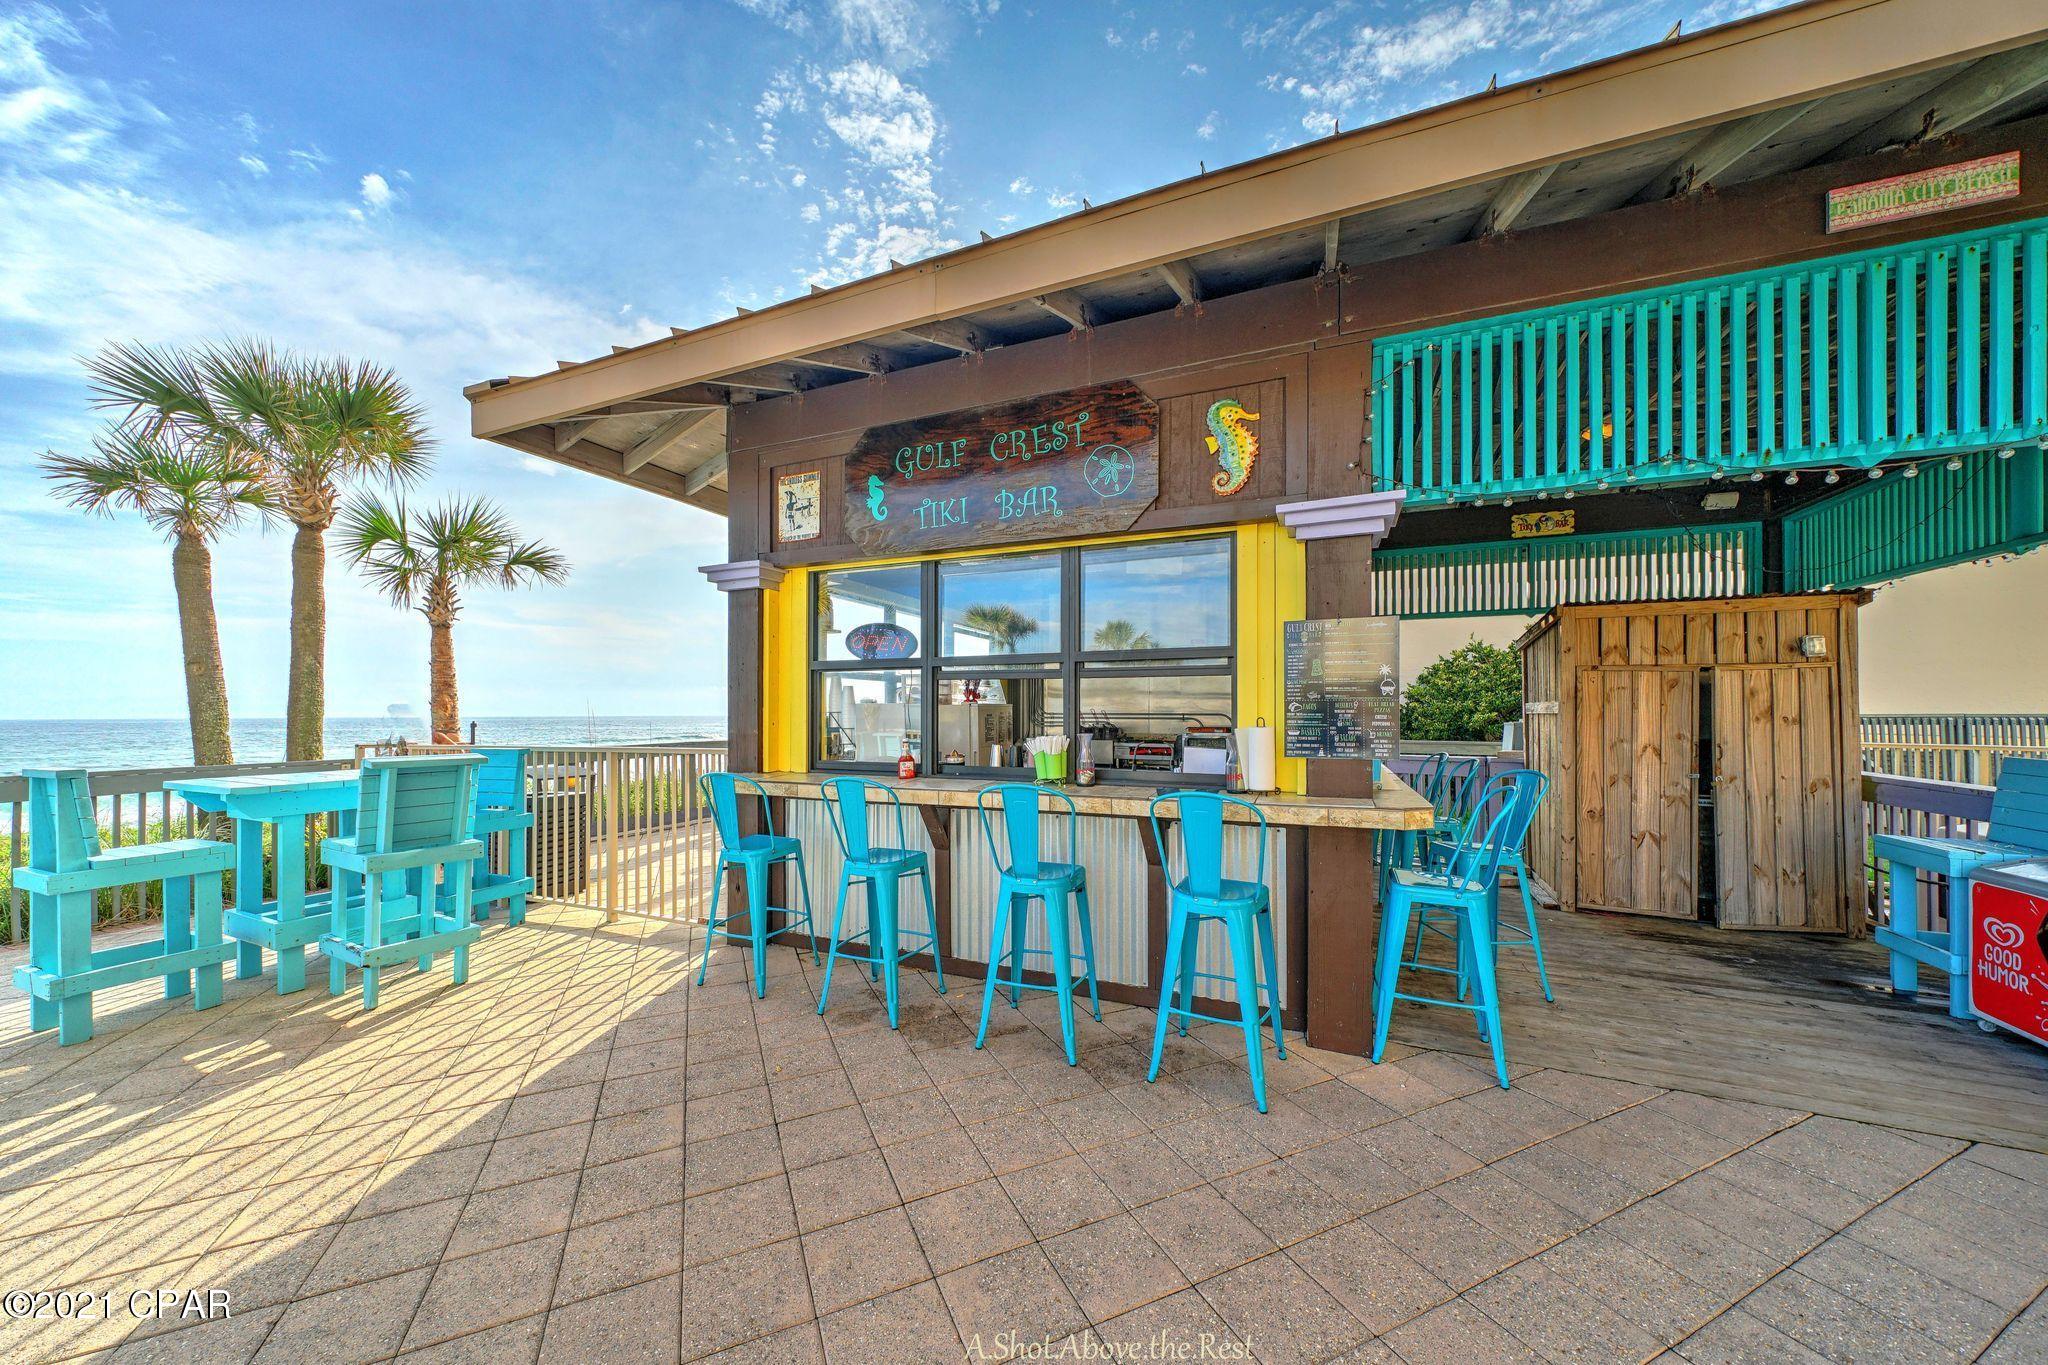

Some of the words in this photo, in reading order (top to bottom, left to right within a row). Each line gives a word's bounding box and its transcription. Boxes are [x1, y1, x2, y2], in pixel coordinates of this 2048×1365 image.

[1912, 176, 1950, 202] CITY
[1955, 163, 2014, 194] BEACH
[895, 438, 968, 479] GULF
[989, 411, 1090, 462] CREST
[912, 496, 970, 530] TIKI
[994, 485, 1064, 520] BAR
[850, 633, 909, 652] OPEN
[1984, 942, 2022, 972] GOOD
[1977, 958, 2031, 996] HUMOR
